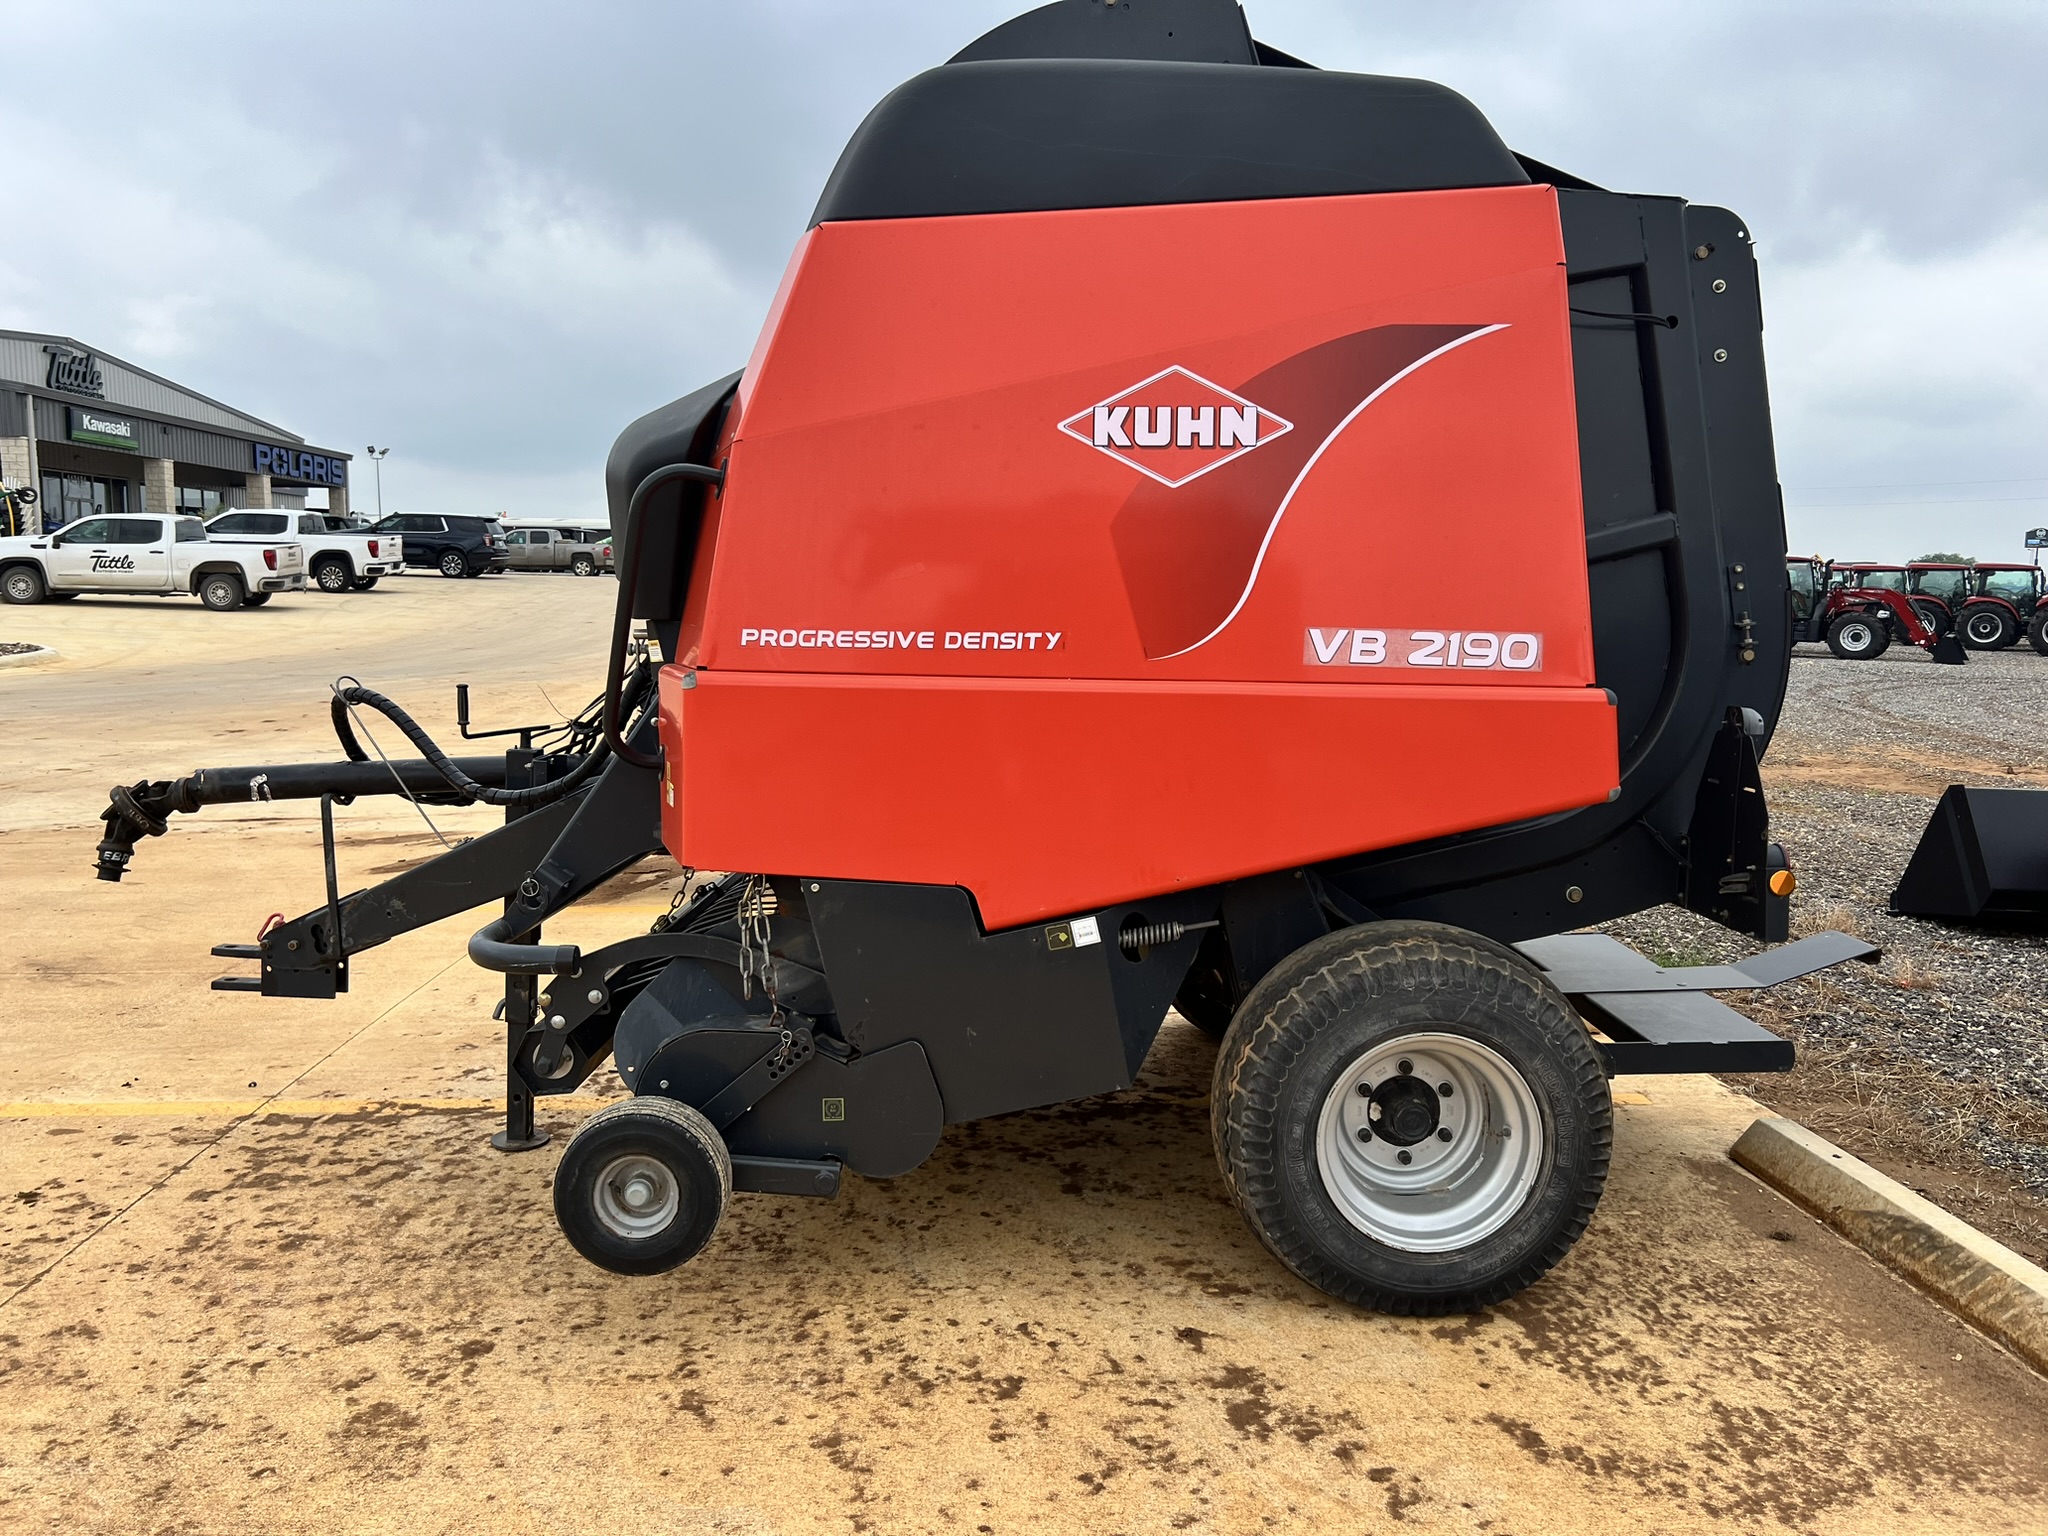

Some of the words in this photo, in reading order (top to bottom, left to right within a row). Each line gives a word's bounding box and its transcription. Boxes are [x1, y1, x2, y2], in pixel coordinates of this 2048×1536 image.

[43, 346, 103, 390] Tuttle
[82, 414, 131, 437] Kawasaki
[1093, 406, 1258, 448] KUHN
[255, 443, 345, 485] POLARIS
[90, 554, 135, 572] Tuttle
[741, 628, 935, 649] PROGRESSIVE
[944, 631, 1062, 650] DENSITY
[1308, 628, 1387, 664] VB
[1407, 631, 1533, 669] 2190
[1533, 1053, 1574, 1141] VREDESTEIN
